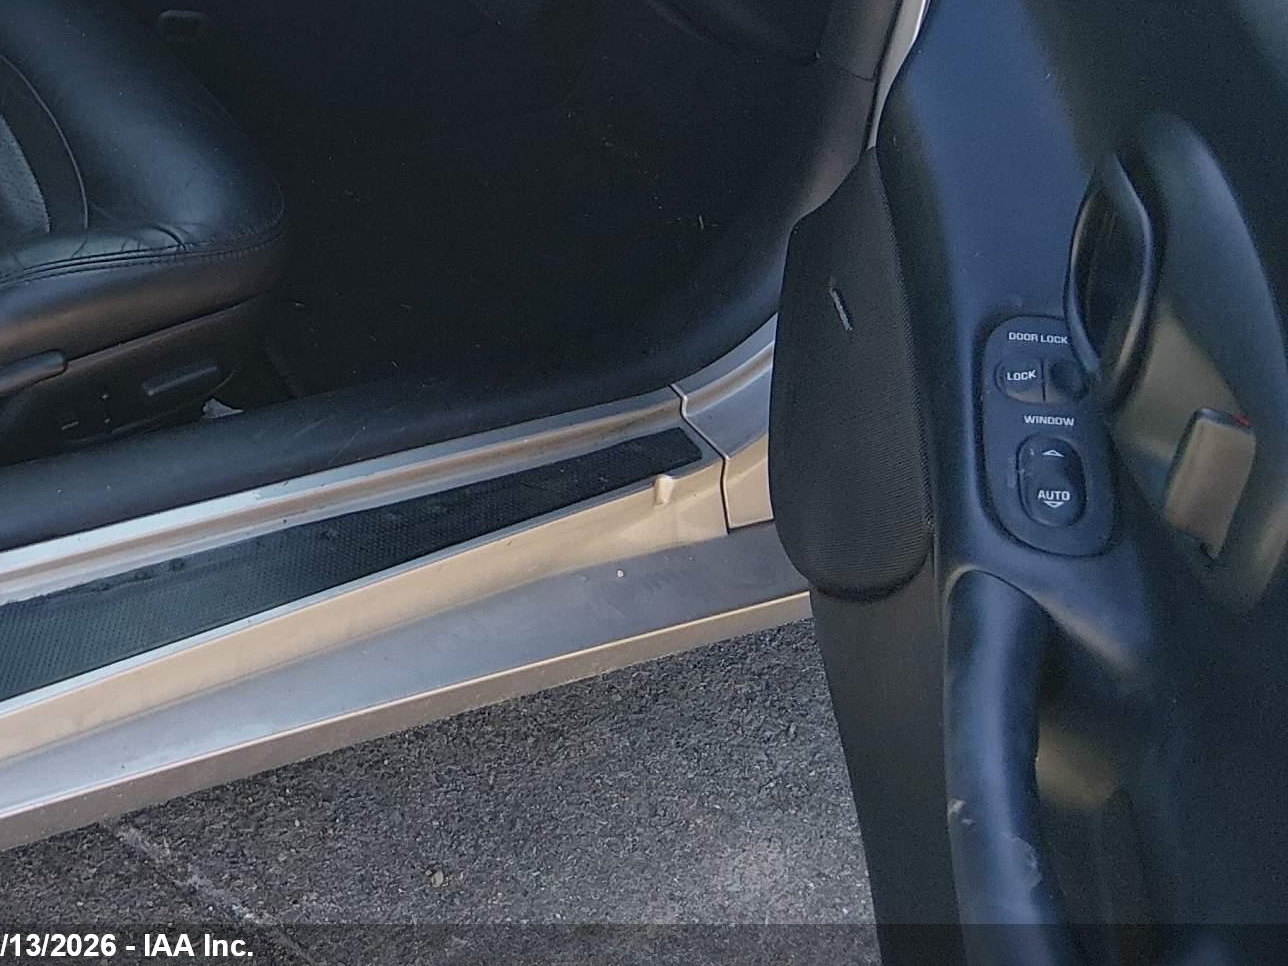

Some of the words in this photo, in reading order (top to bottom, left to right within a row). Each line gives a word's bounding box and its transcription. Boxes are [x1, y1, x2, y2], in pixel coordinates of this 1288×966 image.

[1008, 332, 1039, 342] DOOR
[1040, 334, 1068, 345] LOCK
[1007, 370, 1036, 381] LOCK
[1023, 415, 1075, 427] WINDOW
[1037, 490, 1071, 501] AUTO
